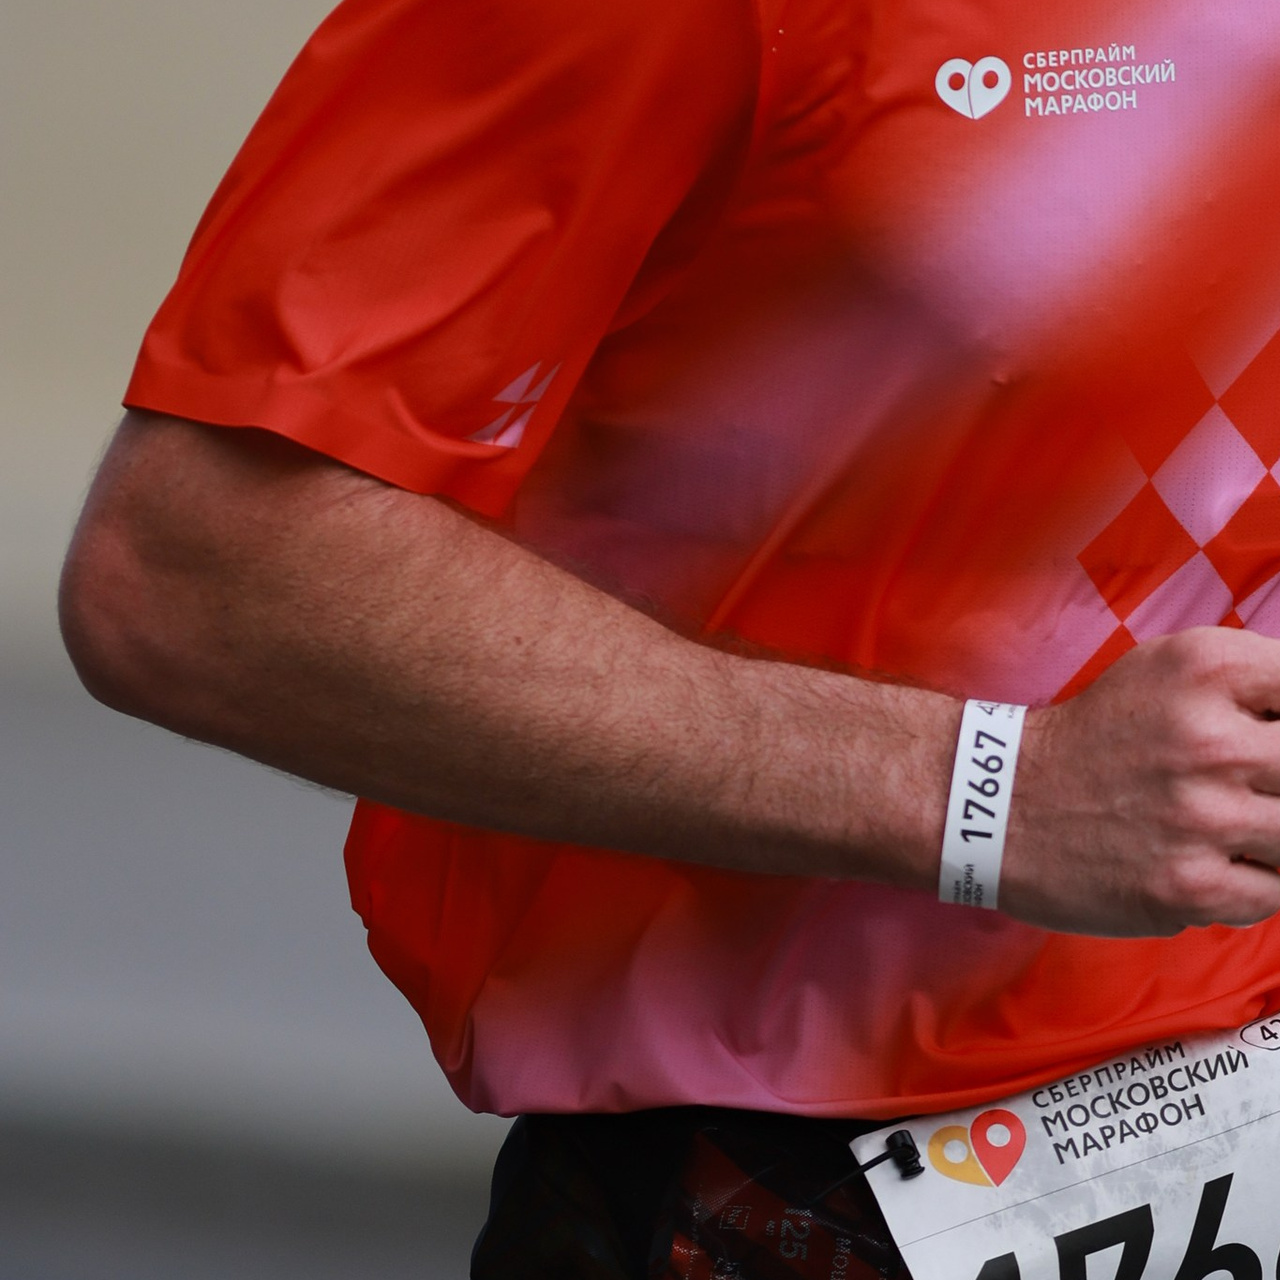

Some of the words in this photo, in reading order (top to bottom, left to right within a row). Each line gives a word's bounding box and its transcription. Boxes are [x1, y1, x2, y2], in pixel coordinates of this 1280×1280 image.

[1023, 43, 1136, 69] СБЕРПРАЙМ
[1024, 58, 1176, 94] МОСКОВСКИЙ
[1025, 90, 1137, 117] МАРАФОН
[960, 730, 1007, 843] 17667
[1032, 1041, 1186, 1109] СБЕРПРАЙМ
[1041, 1045, 1250, 1138] МОСКОВСКИЙ
[1052, 1093, 1206, 1165] МАРАФОН
[779, 1207, 813, 1261] 125
